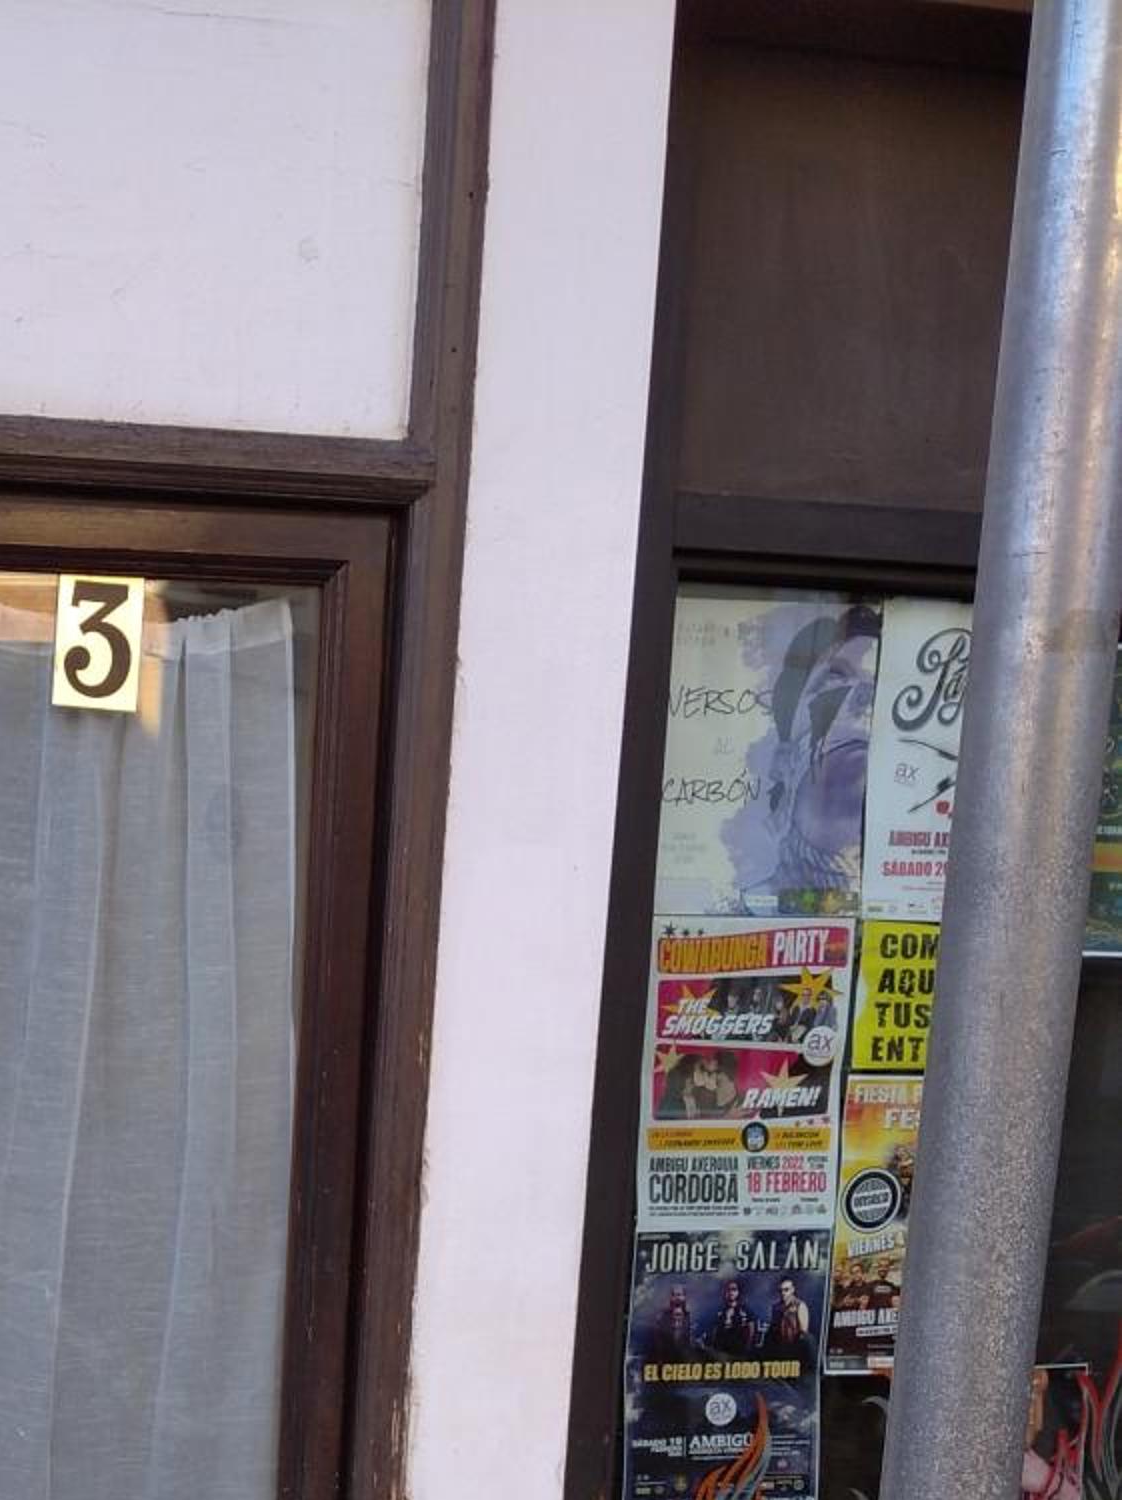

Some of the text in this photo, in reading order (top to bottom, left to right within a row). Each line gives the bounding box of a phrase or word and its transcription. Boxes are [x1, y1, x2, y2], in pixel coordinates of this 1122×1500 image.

[64, 581, 132, 699] 3
[669, 684, 774, 719] VERSOS
[895, 763, 919, 780] ax
[661, 770, 762, 807] CARBÓN
[882, 857, 930, 878] SÁBADO
[660, 929, 831, 973] COWABUNGA PARTY
[878, 968, 935, 997] AQU
[677, 998, 711, 1014] THE
[875, 1002, 931, 1029] TUS
[661, 1013, 775, 1036] SMOGGERS
[807, 1034, 834, 1051] ax
[870, 1036, 924, 1062] ENT
[742, 1086, 821, 1108] RAMEN!
[648, 1173, 738, 1204] CORDOBA
[746, 1171, 827, 1194] 18 FEBRERO
[644, 1235, 820, 1273] JORGE SALÁN
[643, 1363, 659, 1381] EL
[662, 1362, 702, 1381] CIELO
[704, 1361, 723, 1380] ES
[763, 1360, 801, 1378] TOUR
